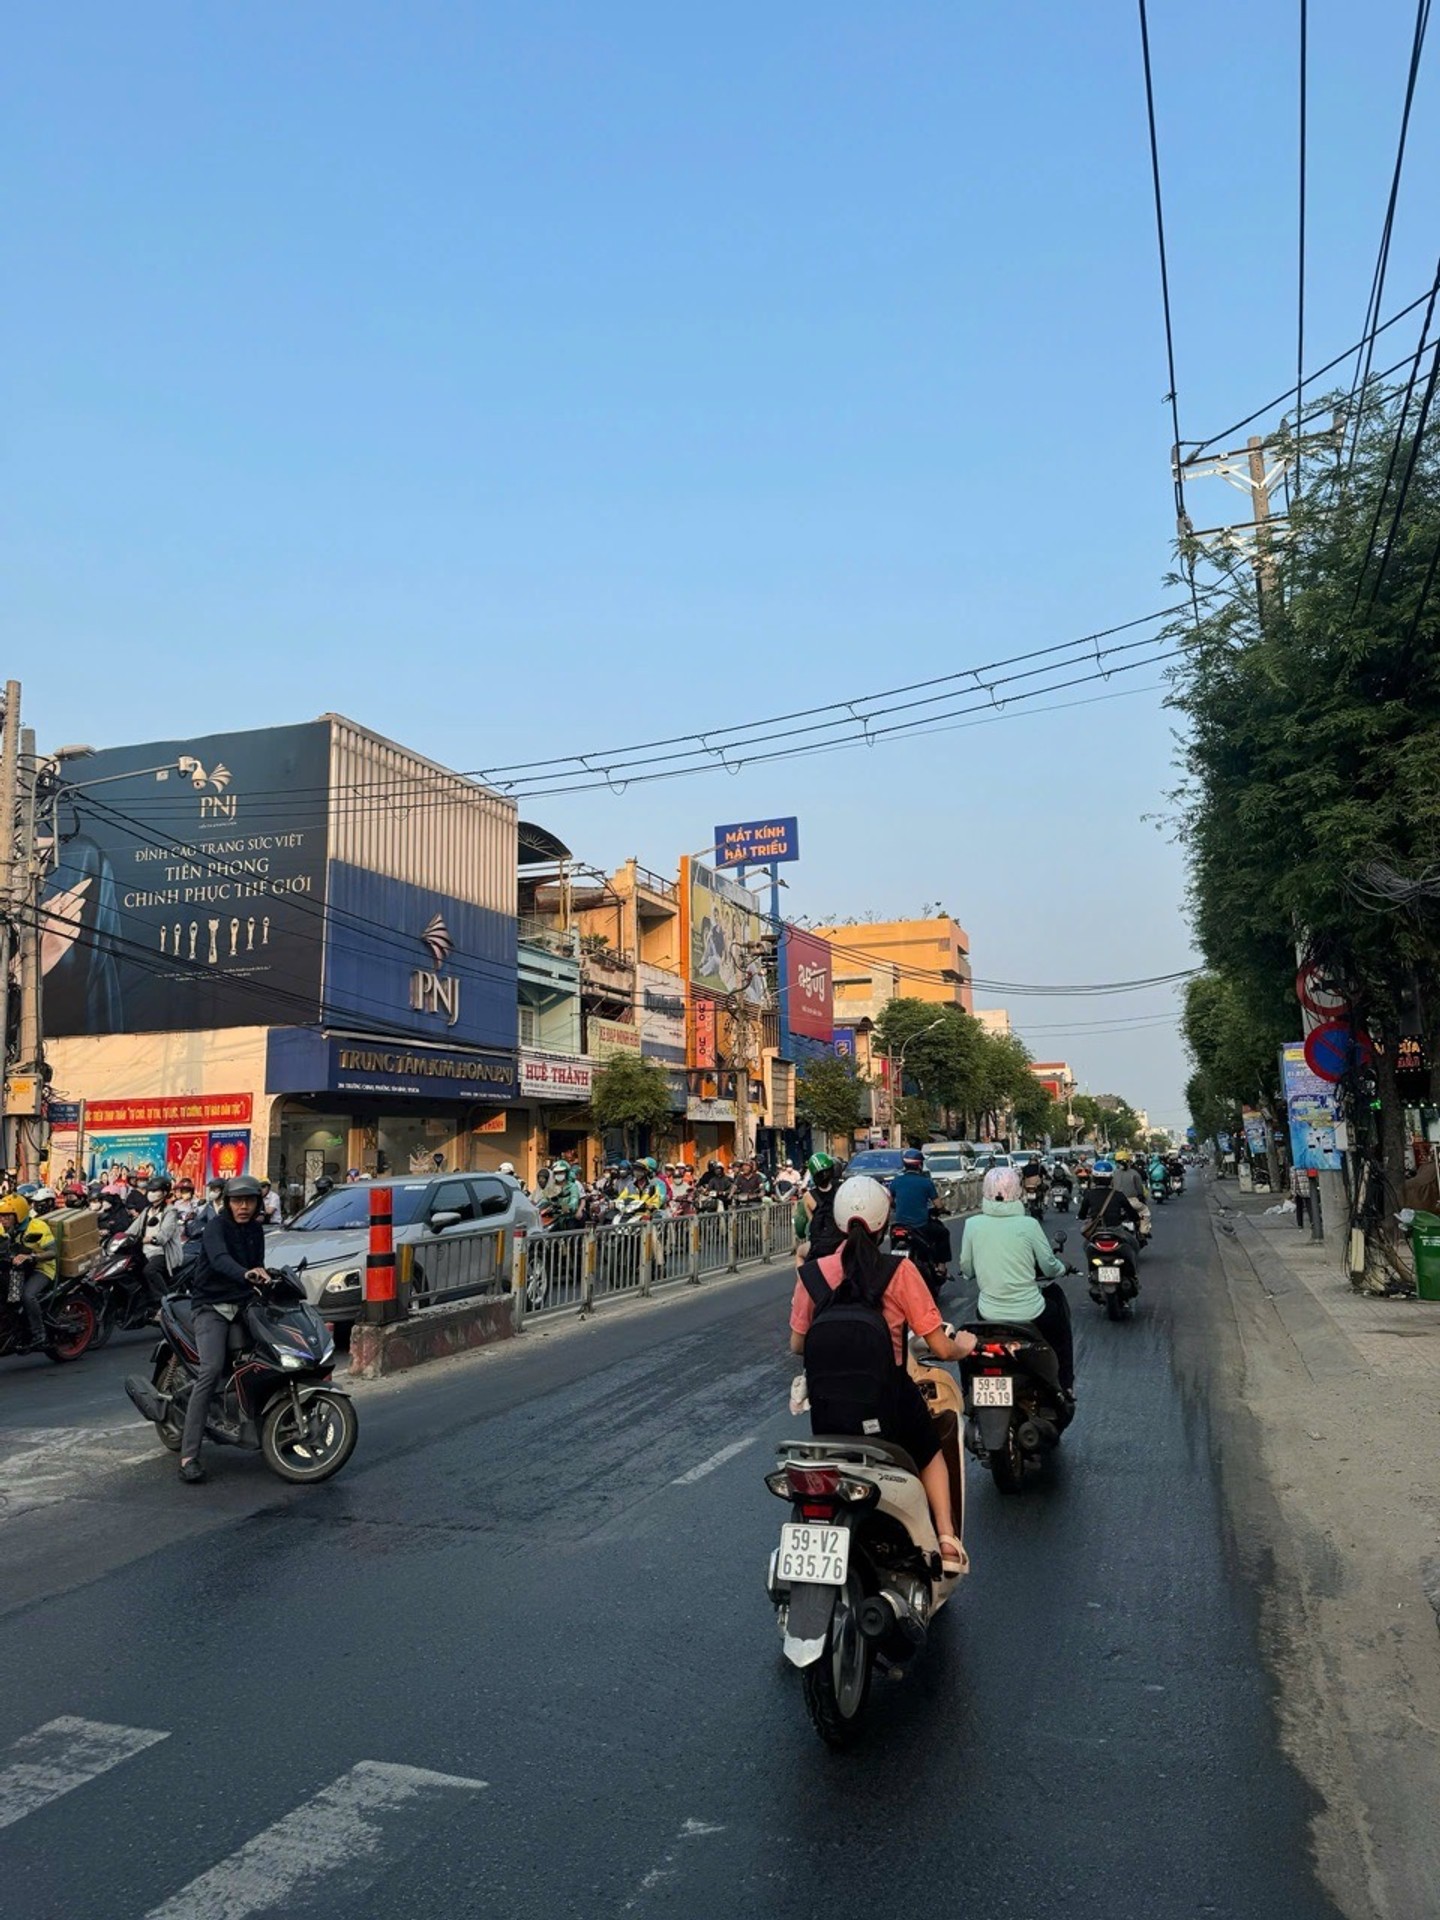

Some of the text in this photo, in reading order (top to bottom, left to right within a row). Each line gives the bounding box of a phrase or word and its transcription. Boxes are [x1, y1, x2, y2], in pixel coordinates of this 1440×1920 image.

[200, 795, 237, 821] PNJ
[171, 845, 197, 859] CAO
[200, 839, 244, 856] TRANG
[247, 836, 273, 851] SỨC
[275, 833, 304, 848] VIỆT
[726, 825, 785, 843] MẮT KÍNH
[207, 858, 269, 878] PHONG
[124, 874, 311, 909] CHINH PHỤC THẾ GIỚI
[411, 969, 459, 1026] PNJ
[339, 1049, 395, 1072] TRUNG
[395, 1052, 428, 1075] TÂM
[428, 1058, 456, 1078] KIM
[493, 1066, 513, 1086] PNJ
[975, 1391, 1011, 1405] 215.19
[791, 1528, 839, 1554] 59-V2
[782, 1553, 843, 1580] 635.76
